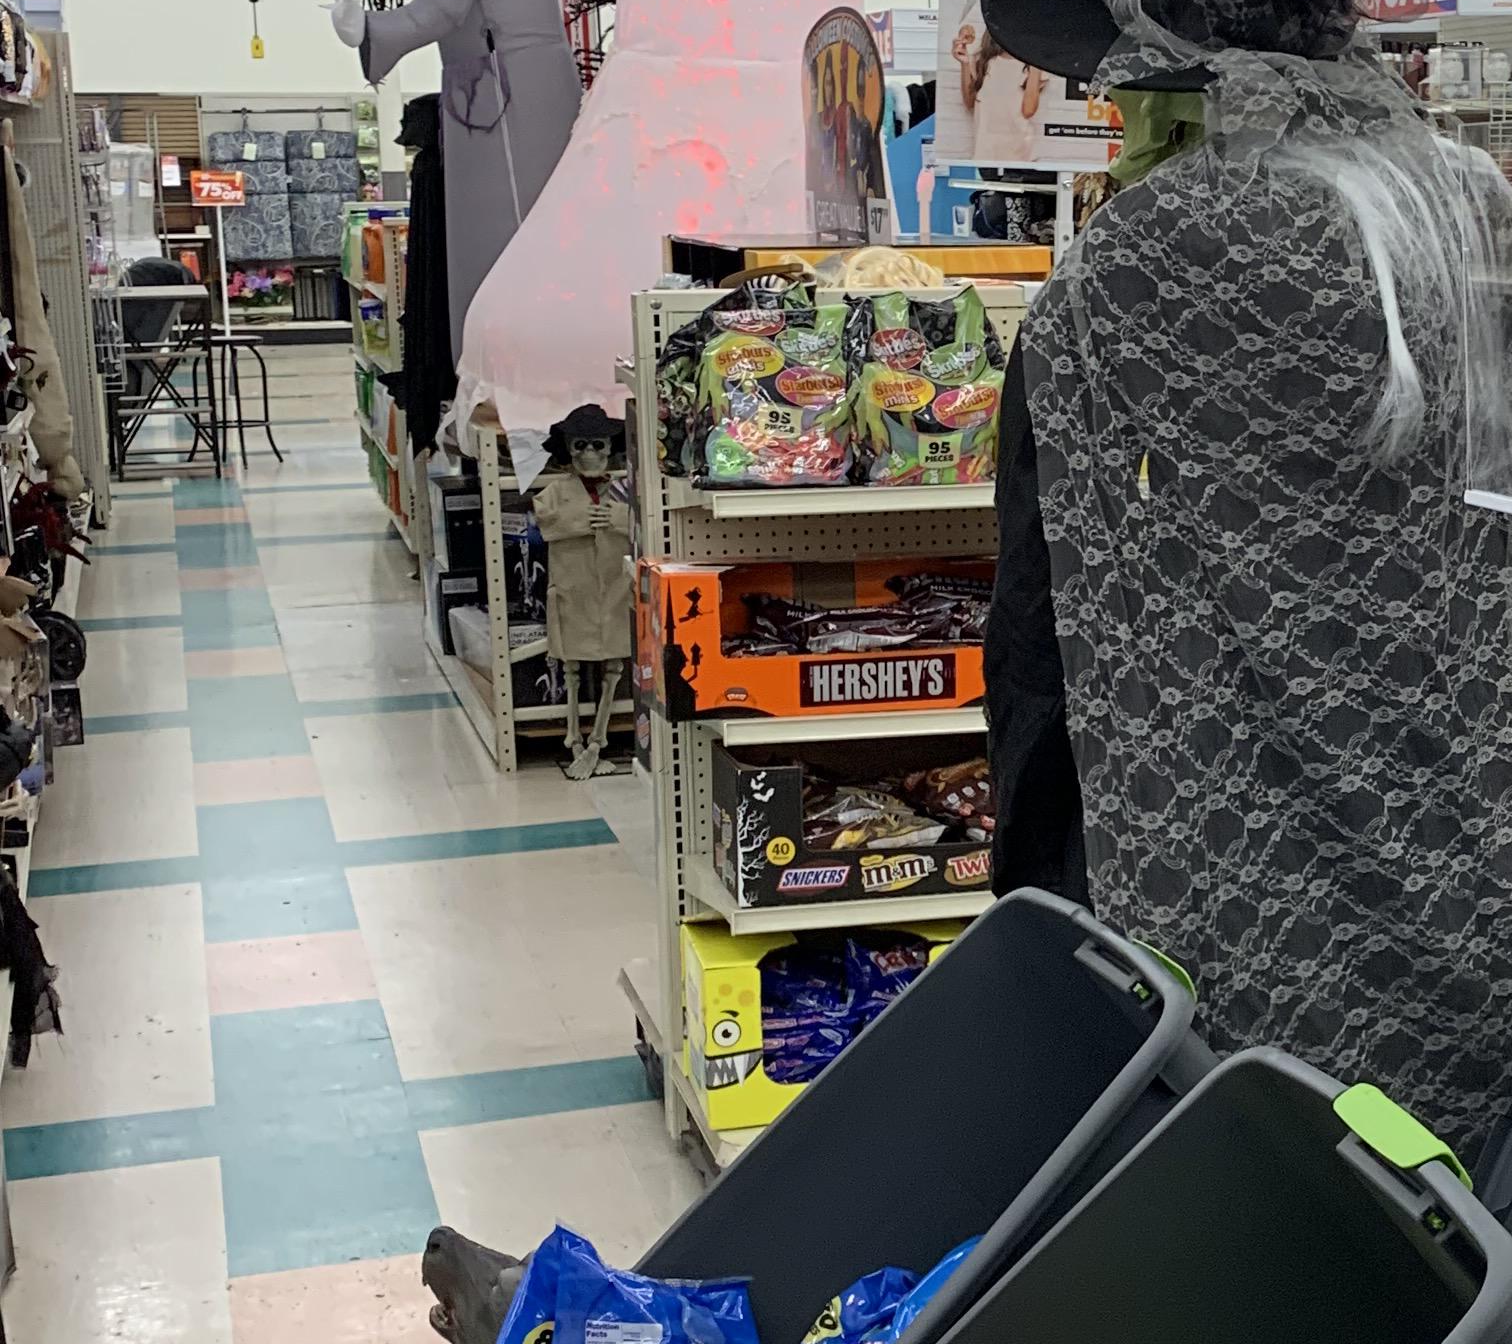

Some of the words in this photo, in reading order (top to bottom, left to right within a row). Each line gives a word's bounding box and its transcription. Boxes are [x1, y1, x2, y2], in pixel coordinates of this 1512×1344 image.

[768, 410, 792, 424] 95
[929, 442, 951, 454] 95
[925, 454, 954, 462] PIECES
[957, 586, 992, 594] CHOCO
[813, 658, 943, 702] HERSHEY'S
[772, 843, 790, 855] 40
[948, 853, 990, 878] Twi
[782, 868, 846, 887] SNICKERS
